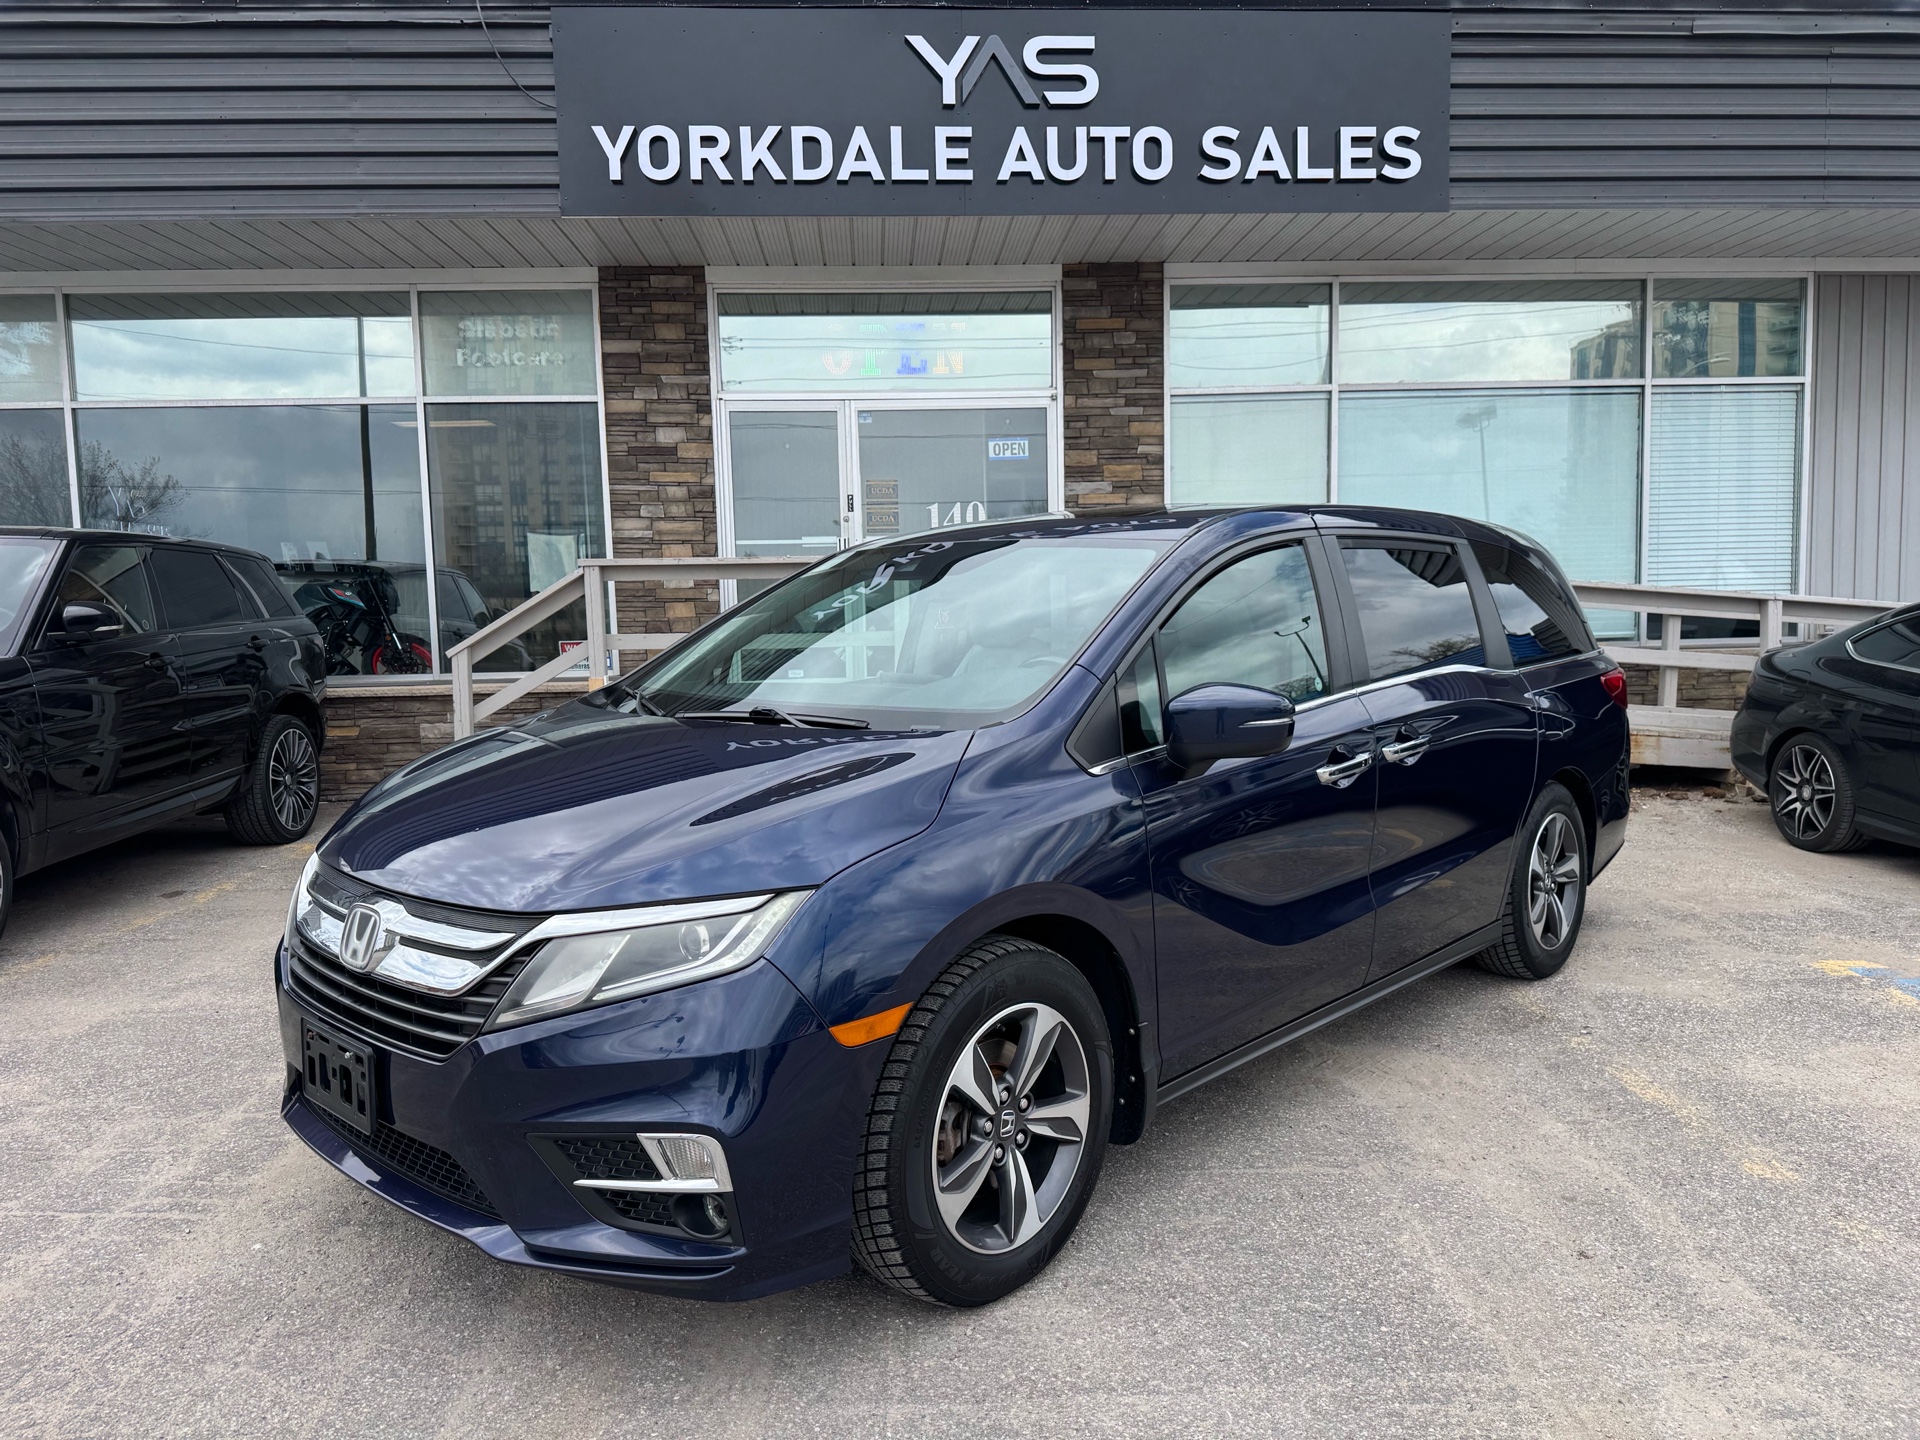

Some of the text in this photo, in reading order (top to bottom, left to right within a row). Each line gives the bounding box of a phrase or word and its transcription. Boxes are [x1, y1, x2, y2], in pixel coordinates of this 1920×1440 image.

[904, 34, 1100, 109] YAS
[591, 125, 1423, 184] YORKDALE AUTO SALES
[993, 443, 1027, 456] OPEN
[926, 501, 986, 529] 140
